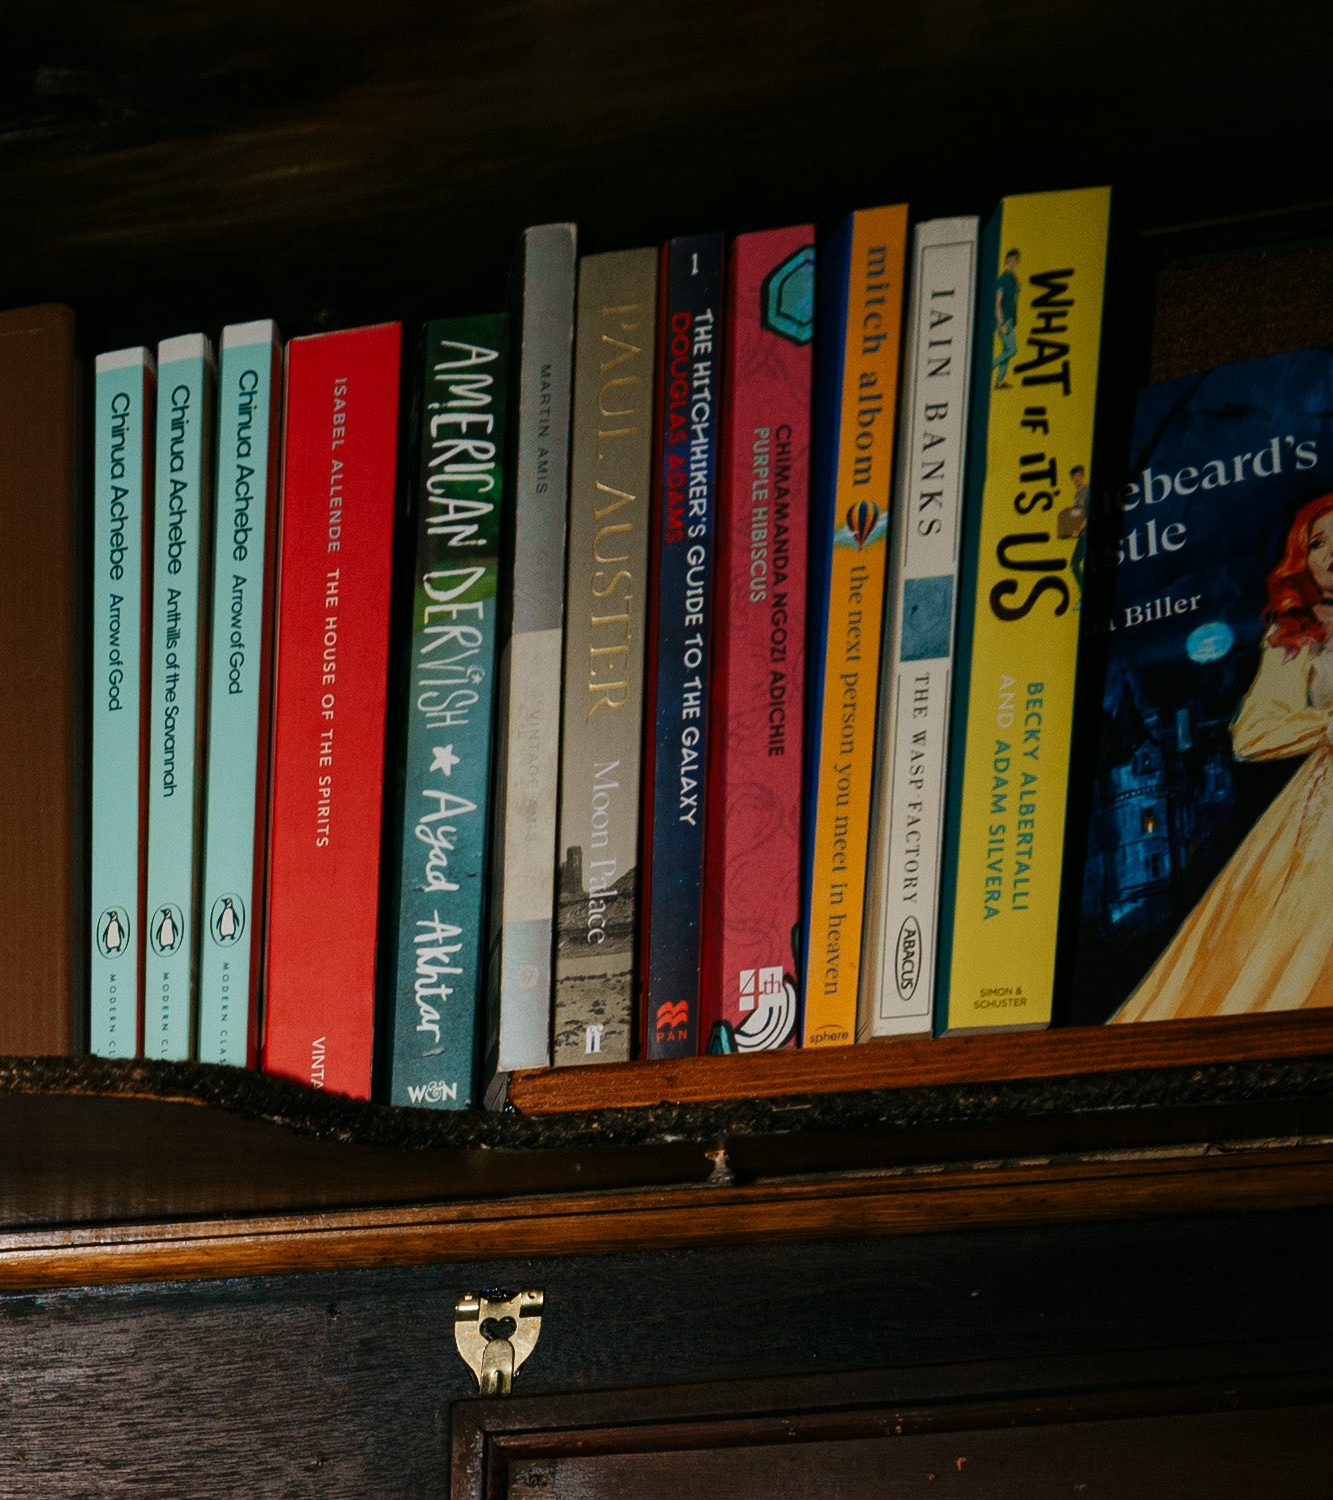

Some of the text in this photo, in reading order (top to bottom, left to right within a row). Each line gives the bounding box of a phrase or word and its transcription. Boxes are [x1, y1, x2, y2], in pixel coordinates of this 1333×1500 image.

[536, 363, 551, 495] MARTIN AMIS
[665, 311, 691, 544] DOUGLAS ADAMS
[853, 246, 887, 487] mitch albom
[917, 290, 955, 536] IAIN BANKS
[989, 268, 1075, 621] WHAT IF IT'S US
[1117, 435, 1318, 512] ebeard's
[108, 392, 131, 712] Chinua Achebe Arrow of God
[163, 385, 191, 797] Chinua Achebe Anthills of the Savannah
[228, 370, 259, 695] Chinua Achebe Arrow of God
[315, 377, 348, 848] ISABEL ALLENDE THE HOUSE OF THE SPIRITS
[417, 340, 499, 730] AMERICAN DERVISH
[583, 303, 642, 728] PAUL AUSTER
[679, 309, 715, 827] THE HITCHHIKER'S GUIDE TO THE GALAXY
[749, 427, 770, 603] PURPLE HIBISCUS
[768, 424, 791, 757] CHIMAMANDA NGOZI ADICHIE
[1124, 593, 1201, 628] Biller
[586, 760, 620, 945] Moon Palace
[824, 565, 868, 996] the next person you meet in heaven
[903, 672, 929, 904] THE WASP FACTORY
[983, 674, 1017, 921] AND ADAM SILVERA
[1012, 682, 1044, 911] BECKY ALBERTALLI
[220, 962, 230, 1023] MODERN
[413, 789, 478, 1057] Ayad Akhtar
[656, 1030, 688, 1043] PAN
[810, 1031, 849, 1045] sphere
[901, 929, 918, 989] ABACUS
[974, 998, 1027, 1010] SCHUSTER
[980, 988, 1012, 997] SIMON
[407, 1079, 457, 1104] W&N
